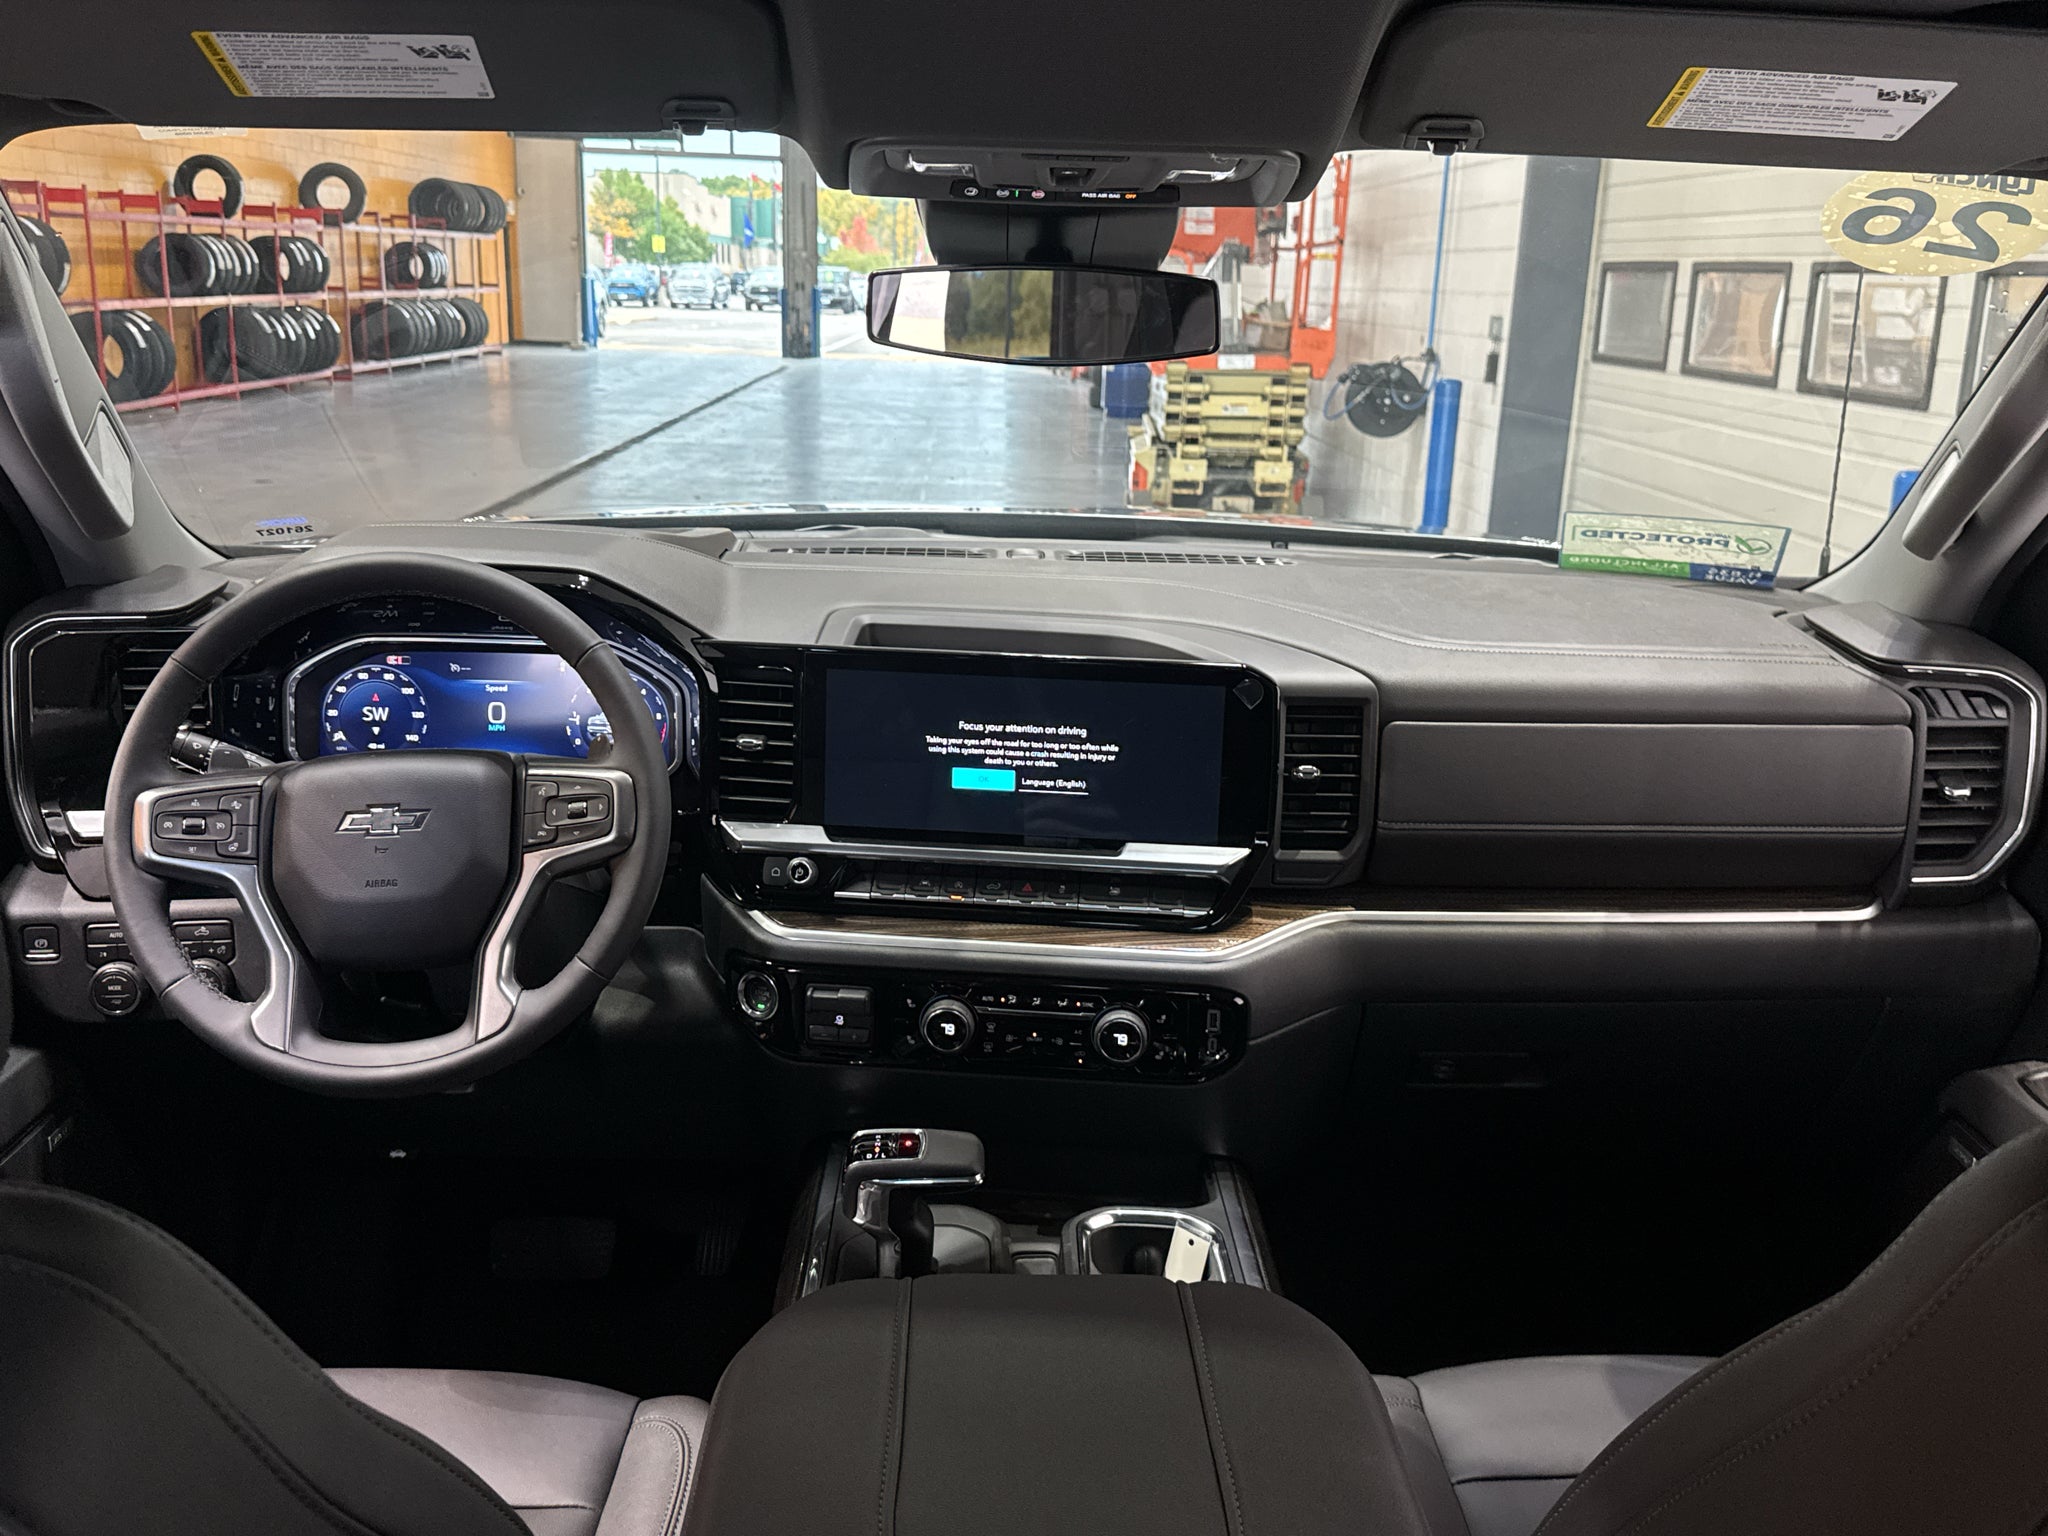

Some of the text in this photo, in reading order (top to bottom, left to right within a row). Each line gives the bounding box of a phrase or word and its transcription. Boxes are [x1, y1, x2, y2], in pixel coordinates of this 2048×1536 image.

[335, 685, 347, 693] 40
[401, 687, 415, 695] 100
[485, 684, 508, 693] Speed
[362, 706, 389, 721] SW
[488, 701, 506, 724] 0
[959, 721, 983, 731] Focus
[985, 725, 1004, 733] your
[1005, 724, 1044, 734] attention
[1058, 726, 1087, 738] driving
[405, 734, 419, 742] 140
[926, 736, 947, 745] Taking
[980, 738, 991, 746] off
[1004, 740, 1019, 748] road
[1020, 740, 1030, 748] for
[1044, 741, 1059, 750] long
[1081, 743, 1100, 751] often
[1101, 744, 1119, 752] while
[928, 746, 947, 754] using
[948, 746, 960, 754] this
[1005, 749, 1024, 757] cause
[1031, 750, 1049, 758] crash
[1050, 750, 1080, 761] resulting
[1088, 752, 1107, 762] injury
[984, 756, 1004, 765] death
[1034, 759, 1059, 768] others.
[1022, 777, 1087, 789] Language (English)
[364, 879, 398, 888] AIRBAG
